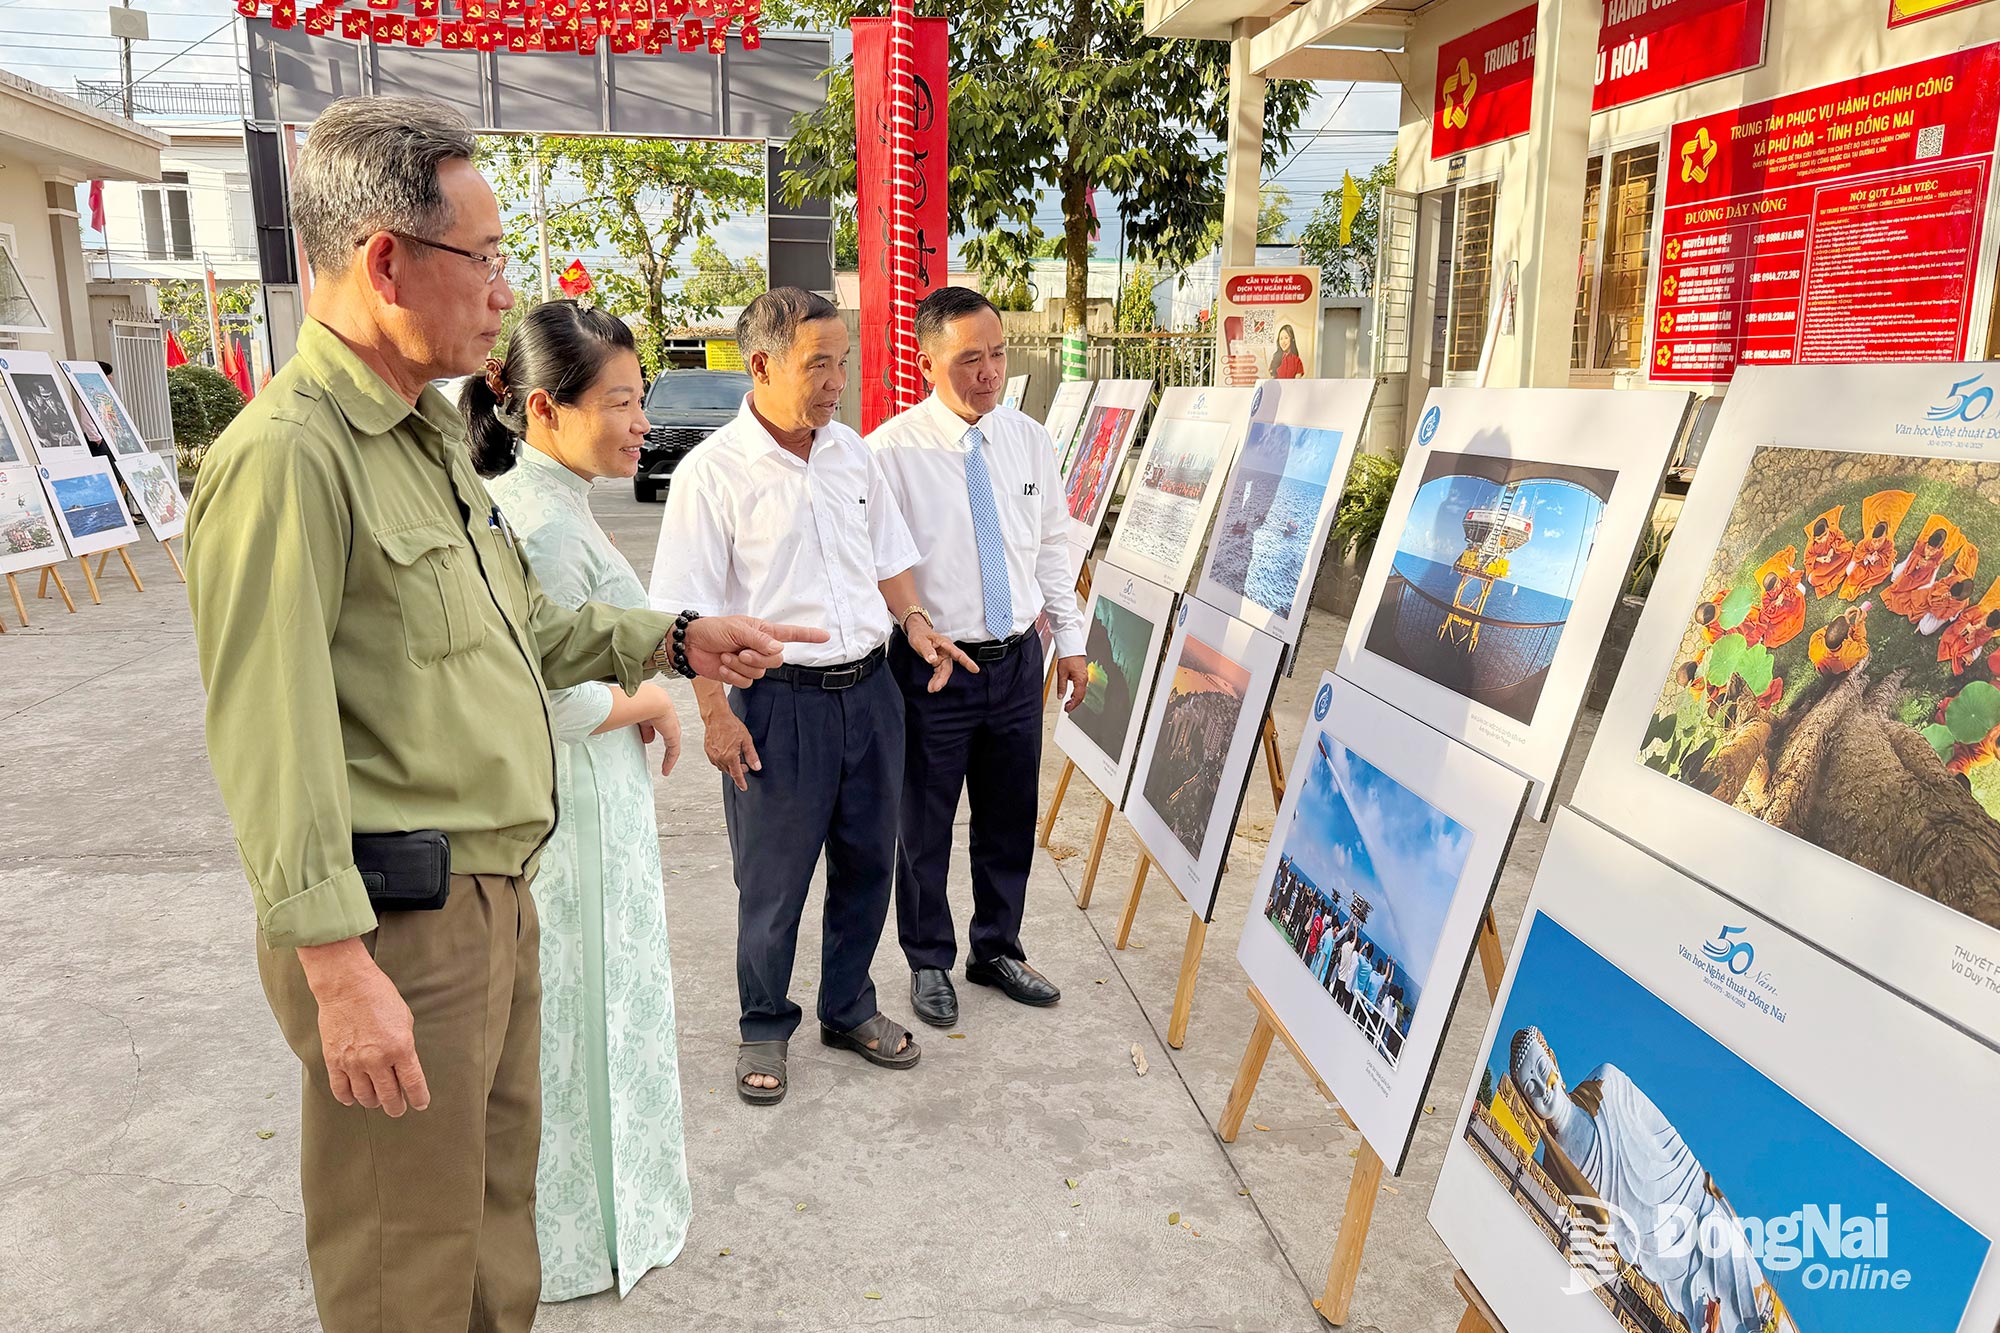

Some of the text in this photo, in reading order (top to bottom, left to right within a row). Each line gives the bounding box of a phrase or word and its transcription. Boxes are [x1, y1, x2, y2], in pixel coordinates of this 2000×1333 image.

[1484, 27, 1535, 75] TRUNG TÂ
[1610, 33, 1648, 81] HÒA
[1730, 75, 1954, 140] TRUNG TÂM PHỤC VỤ HÀNH CHÍNH CÔNG
[1752, 139, 1766, 158] XÃ
[1767, 133, 1790, 155] PHÚ
[1792, 129, 1814, 149] HÒA
[1826, 122, 1853, 142] TỈNH
[1854, 114, 1889, 136] ĐỒNG
[1892, 109, 1915, 129] NAI
[1684, 197, 1788, 225] ĐƯỜNG DÂY NÓNG
[1849, 179, 1939, 203] NỘI QUY LÀM VIỆC
[1895, 423, 1912, 435] Văn
[1930, 425, 1956, 438] Nghệ
[1678, 943, 1788, 1024] Văn học Nghệ thuật Đồng Nai
[1964, 966, 1984, 986] Duy
